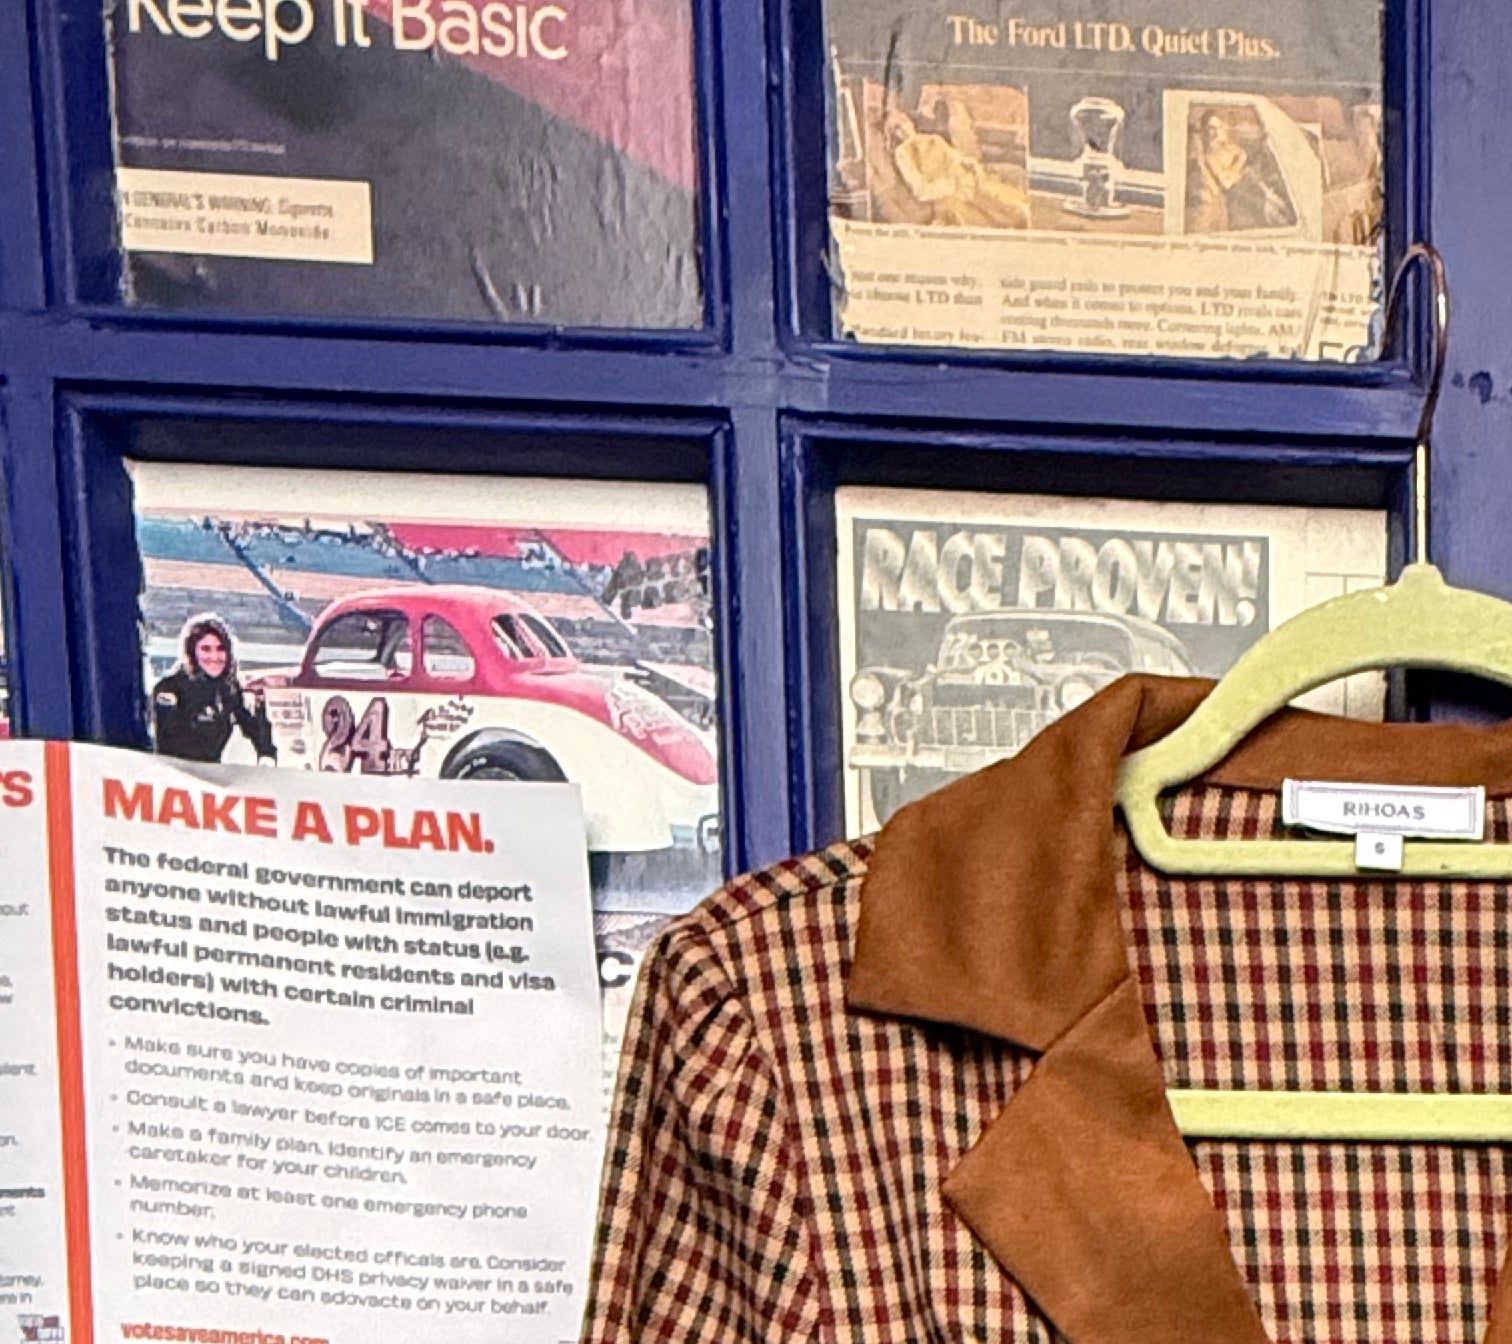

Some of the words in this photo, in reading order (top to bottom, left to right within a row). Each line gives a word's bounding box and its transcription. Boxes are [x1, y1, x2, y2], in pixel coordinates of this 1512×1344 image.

[393, 0, 568, 59] Basic
[947, 16, 998, 45] The
[1008, 18, 1065, 48] Ford
[1075, 21, 1135, 51] LTD.
[1141, 24, 1209, 56] Quiet
[1218, 28, 1280, 59] Plus.
[861, 528, 1008, 613] RACE
[319, 695, 390, 775] 24
[103, 778, 277, 838] MAKE
[291, 800, 333, 844] A
[343, 804, 495, 854] PLAN.
[1342, 800, 1426, 820] RIHOAS
[1374, 842, 1386, 855] S
[103, 846, 150, 869] The
[157, 851, 248, 880] federal
[256, 867, 405, 895] government
[411, 880, 452, 899] can
[458, 881, 533, 903] deport
[105, 877, 201, 902] anyone
[208, 888, 309, 915] without
[314, 900, 390, 924] lawful
[396, 906, 533, 932] immigration
[105, 907, 192, 930] status
[199, 916, 247, 937] and
[253, 923, 339, 948] people
[345, 933, 398, 954] with
[404, 938, 480, 959] status
[107, 933, 188, 959] lawful
[194, 944, 336, 977] permanent
[341, 963, 455, 986] residents
[461, 971, 503, 989] and
[509, 971, 556, 991] visa
[107, 962, 214, 993] holders)
[220, 976, 278, 998] with
[284, 985, 375, 1009] certain
[380, 993, 474, 1016] criminal
[109, 994, 270, 1025] convictions.
[124, 1035, 181, 1055] Make
[187, 1043, 233, 1061] sure
[238, 1049, 276, 1067] you
[282, 1052, 330, 1073] have
[335, 1062, 400, 1080] copies
[405, 1065, 425, 1081] of
[124, 1059, 244, 1085] documents
[250, 1073, 289, 1090] and
[295, 1076, 343, 1097] keep
[347, 1083, 430, 1104] originals
[472, 1091, 513, 1108] safe
[126, 1089, 208, 1112] Consult
[213, 1099, 226, 1114] a
[231, 1099, 298, 1122] lawyer
[304, 1108, 370, 1131] before
[376, 1115, 406, 1132] ICE
[411, 1121, 470, 1136] comes
[475, 1121, 496, 1136] to
[499, 1123, 542, 1138] your
[128, 1120, 184, 1140] Make
[189, 1128, 202, 1142] a
[207, 1128, 271, 1151] family
[409, 1150, 431, 1165] an
[436, 1150, 537, 1170] emergency
[128, 1145, 231, 1167] caretaker
[237, 1153, 267, 1171] for
[272, 1159, 319, 1177] your
[130, 1173, 231, 1199] Memorize
[237, 1186, 261, 1201] at
[266, 1187, 316, 1207] least
[321, 1194, 359, 1211] one
[364, 1198, 467, 1220] emergency
[472, 1203, 528, 1220] phone
[132, 1228, 189, 1247] Know
[194, 1233, 238, 1252] who
[242, 1239, 288, 1255] your
[293, 1243, 368, 1264] elected
[486, 1255, 566, 1273] Consider
[133, 1251, 214, 1274] keeping
[219, 1260, 232, 1274] a
[238, 1259, 306, 1280] signed
[311, 1266, 354, 1284] DHS
[358, 1271, 429, 1291] privacy
[434, 1276, 492, 1292] waiver
[534, 1279, 573, 1296] safe
[133, 1274, 189, 1291] place
[195, 1279, 220, 1294] so
[225, 1280, 273, 1302] they
[278, 1286, 315, 1303] can
[416, 1296, 440, 1312] on
[445, 1299, 485, 1315] your
